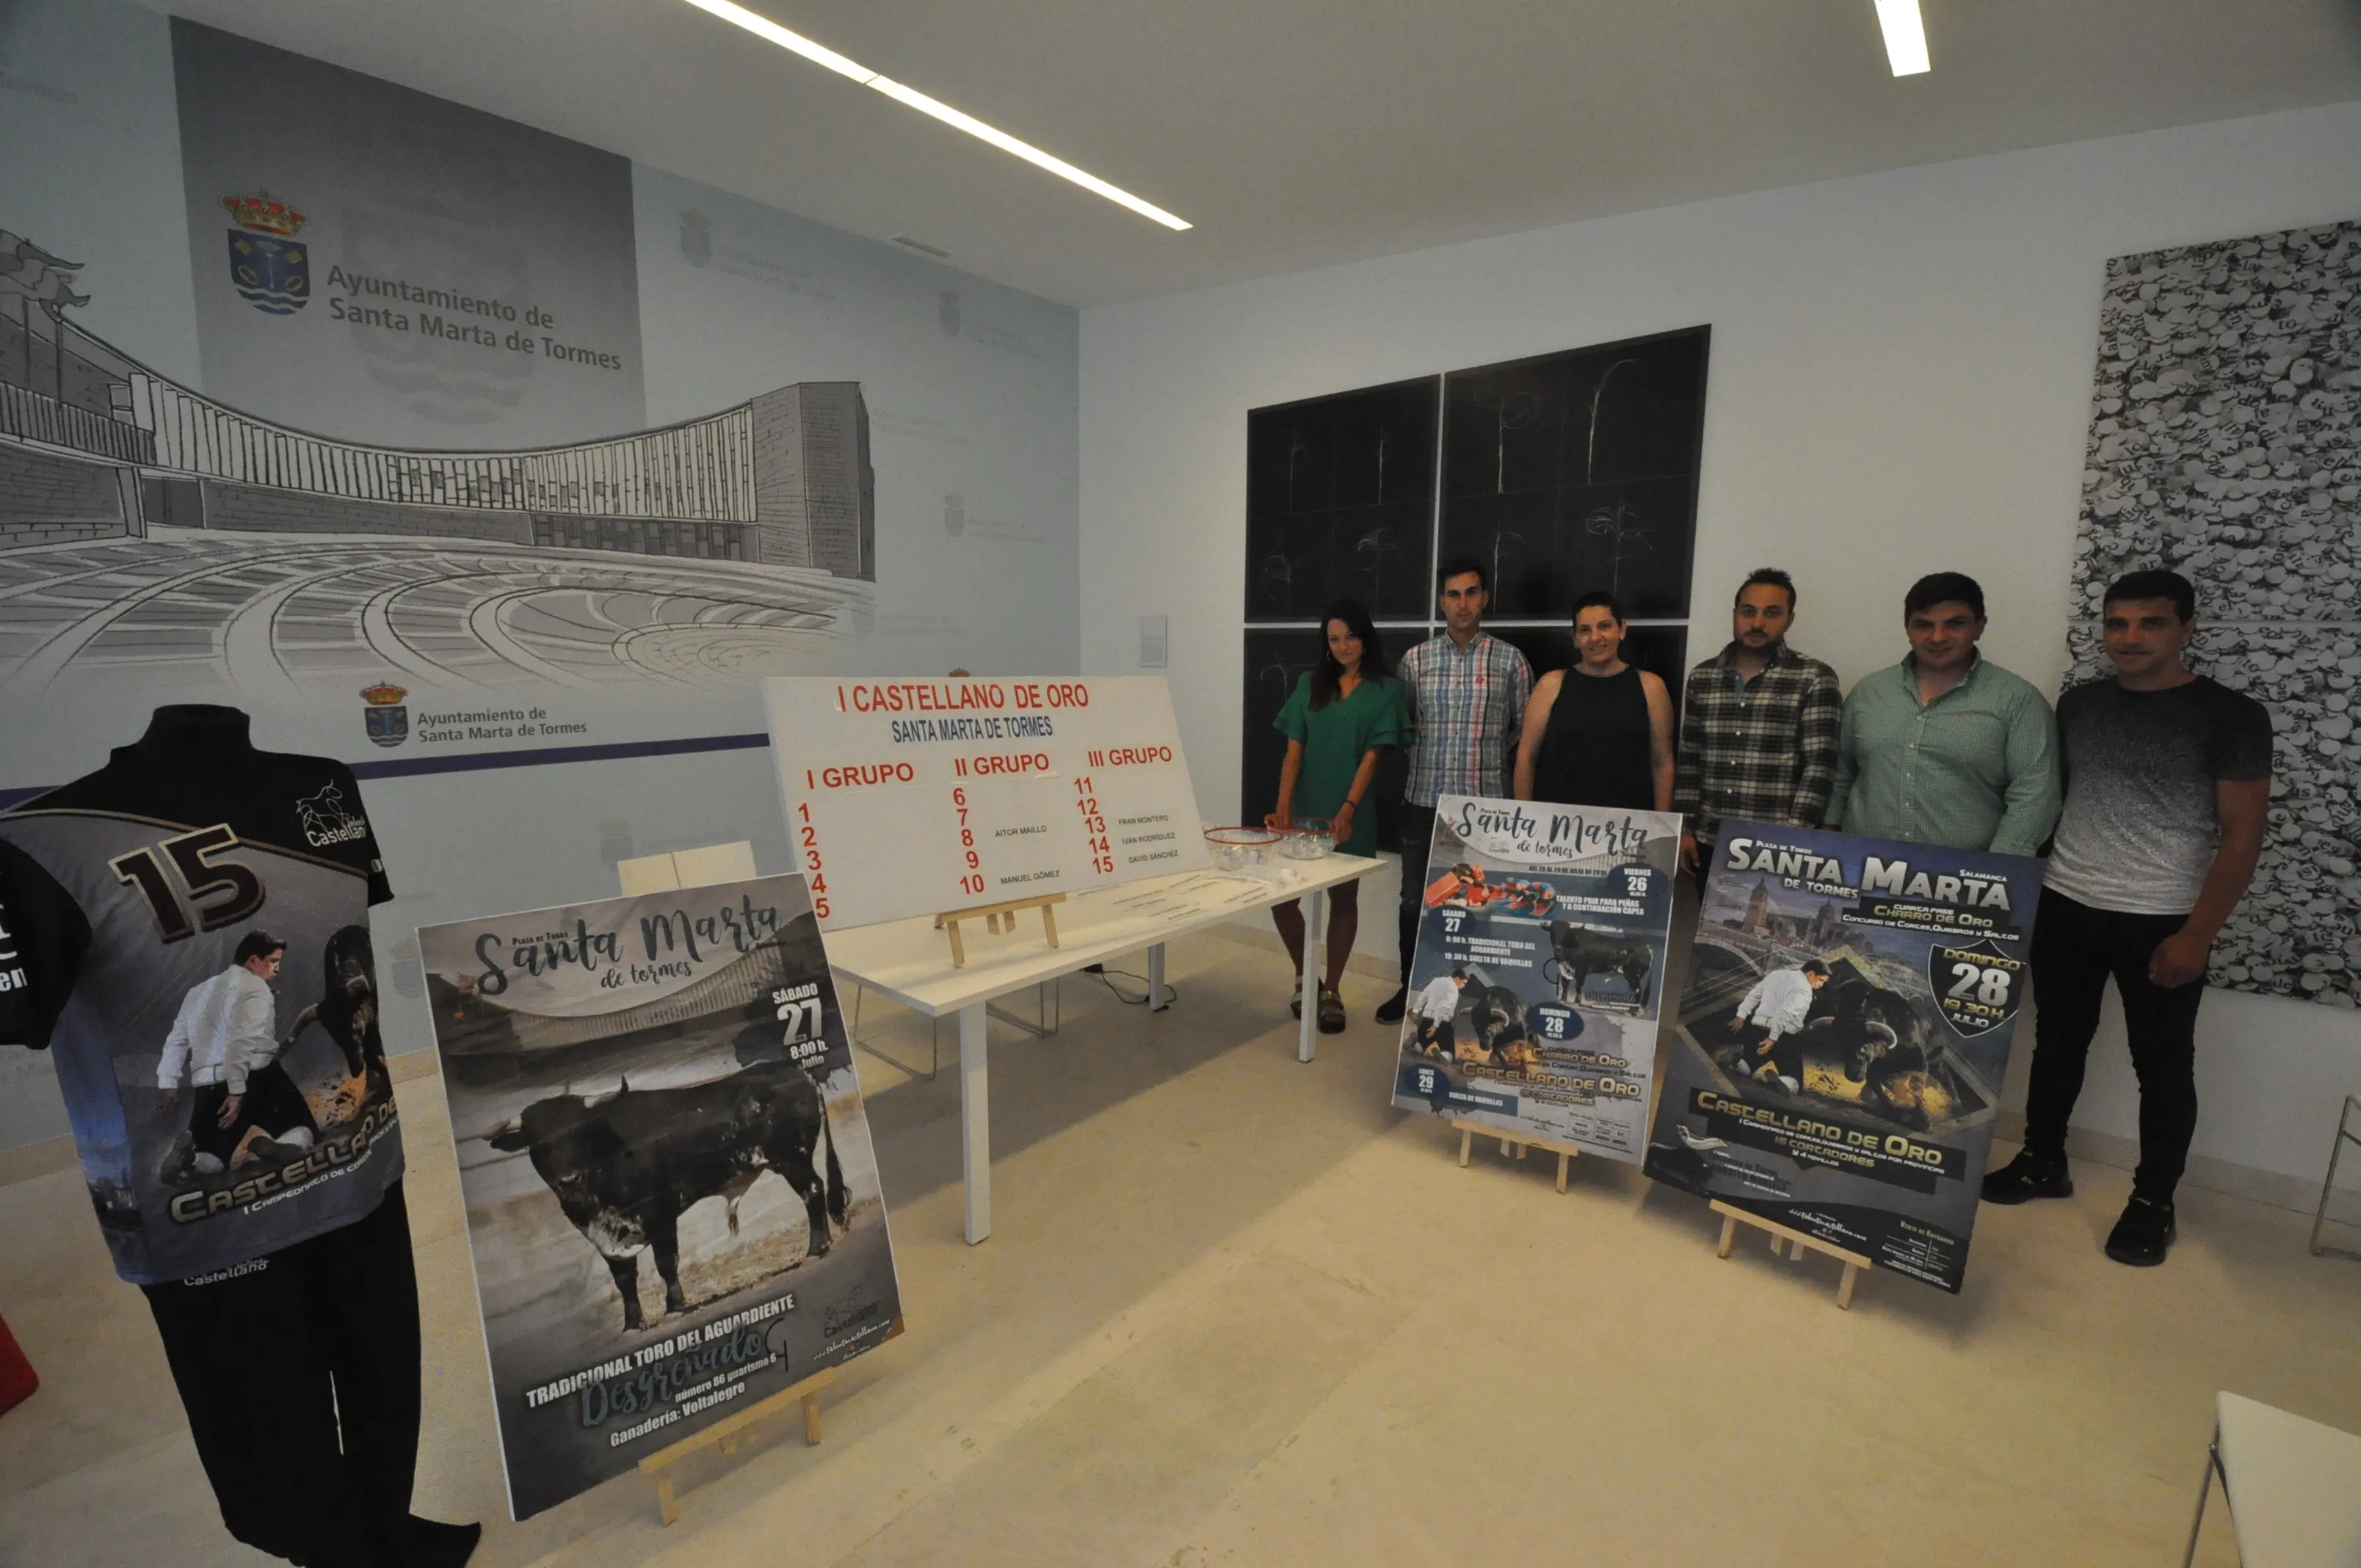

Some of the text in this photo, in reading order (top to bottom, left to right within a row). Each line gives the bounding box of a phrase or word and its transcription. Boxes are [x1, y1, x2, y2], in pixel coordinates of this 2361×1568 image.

[327, 265, 554, 328] Ayuntamiento de
[330, 298, 621, 369] Santa Marta de Tormes
[838, 683, 1089, 712] I CASTELLANO DE ORO
[417, 708, 546, 726] Ayuntamiento de
[419, 723, 587, 743] Santa Marta de Tormes
[892, 716, 1053, 743] SANTA MARTA DE TORMES
[954, 753, 1049, 777] II GRUPO
[1088, 747, 1172, 767] III GRUPO
[807, 763, 914, 790] I GRUPO
[1074, 777, 1093, 795] 11
[953, 788, 965, 806] 6
[1077, 798, 1099, 816] 12
[798, 802, 810, 823] 1
[956, 808, 968, 827] 7
[1084, 815, 1169, 834] 13 FRAN MONTERO
[1457, 802, 1647, 856] Santa Marta
[307, 824, 366, 846] Castellan
[801, 827, 817, 847] 2
[961, 825, 1047, 847] 8 AITOR MAILLO
[1088, 836, 1110, 854] 14
[1517, 840, 1531, 852] de
[806, 850, 822, 871] 3
[965, 850, 979, 869] 9
[1092, 856, 1114, 874] 15
[1128, 854, 1148, 864] DAVID
[1624, 868, 1652, 876] VIERNES
[109, 823, 266, 944] 15
[811, 873, 827, 893] 4
[960, 870, 1060, 895] 10 MANUEL GÓMEZ
[1628, 876, 1647, 891] 26
[1784, 878, 1859, 899] DE TORMES
[816, 897, 830, 918] 5
[1600, 898, 1617, 906] PARA
[1445, 918, 1460, 932] 27
[475, 894, 783, 996] Santa Marta
[1468, 937, 1506, 948] TRADICIONAL
[601, 960, 692, 988] de tormes
[1948, 962, 2011, 1006] 28
[772, 983, 818, 1004] SÁBADO
[777, 997, 822, 1046] 27
[1539, 1008, 1570, 1018] DOMINGO
[1951, 1012, 1990, 1028] JULIO
[1545, 1017, 1564, 1034] 28
[790, 1039, 829, 1059] 8:00 h.
[1418, 1075, 1434, 1089] 29
[526, 1294, 795, 1408] TRADICIONAL TORO DEL AGUARDIENTE
[581, 1324, 761, 1427] Desgreñado
[675, 1352, 777, 1403] número 86 guarismo 6
[610, 1382, 746, 1448] Ganadería: Voltalegre
